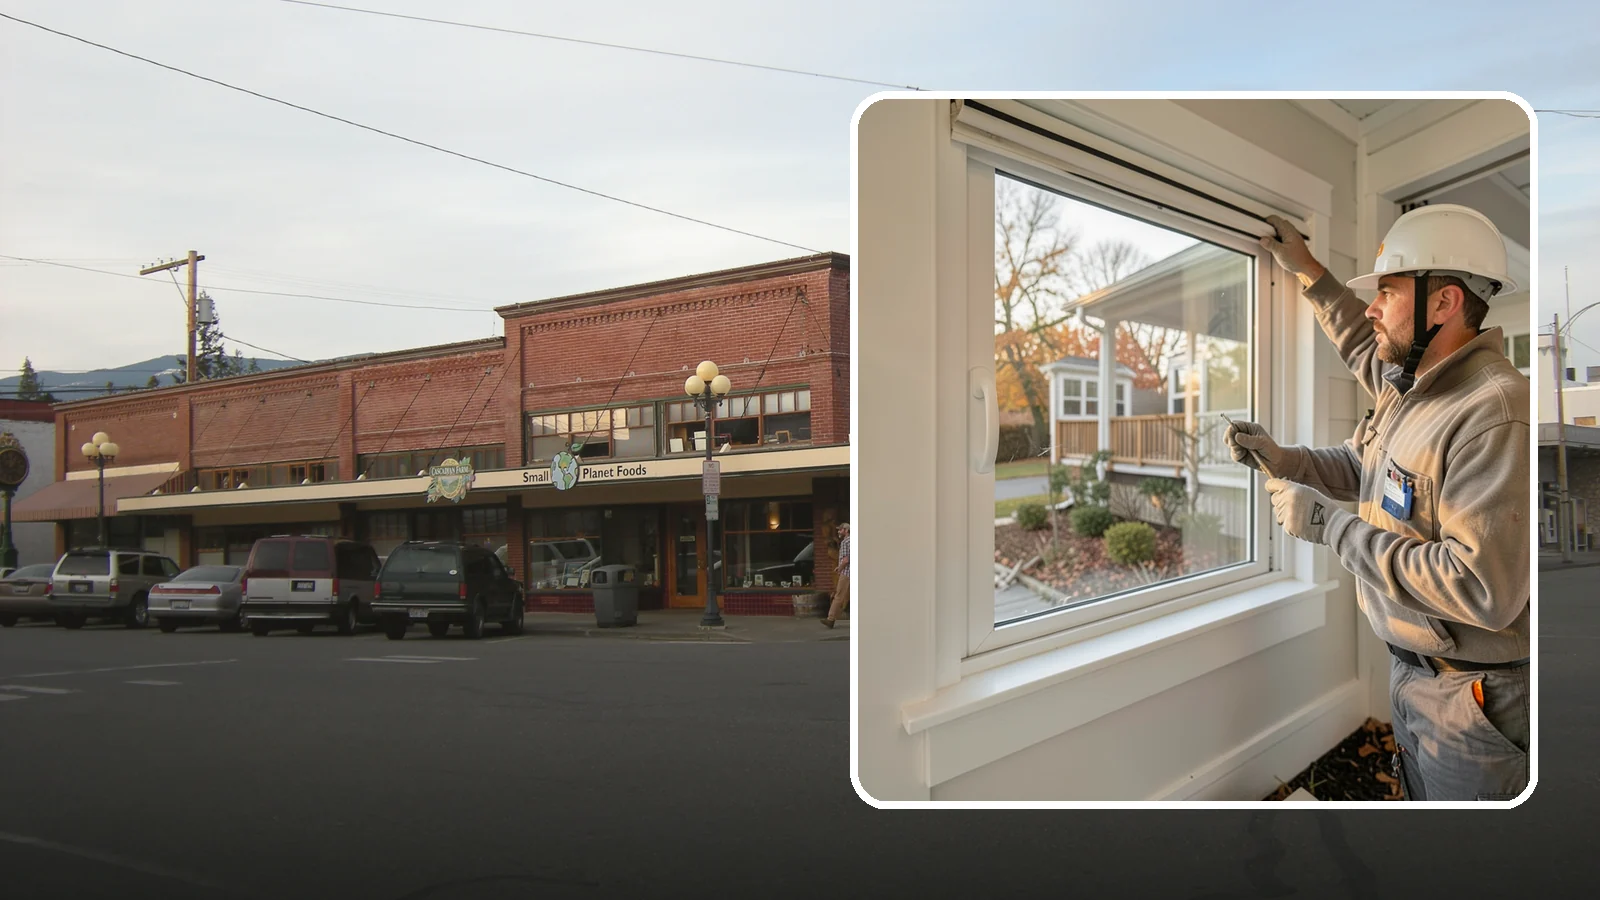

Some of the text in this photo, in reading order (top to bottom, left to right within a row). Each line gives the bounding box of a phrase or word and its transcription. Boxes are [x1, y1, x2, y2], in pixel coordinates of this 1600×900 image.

[523, 464, 647, 483] Small Planet Foods
